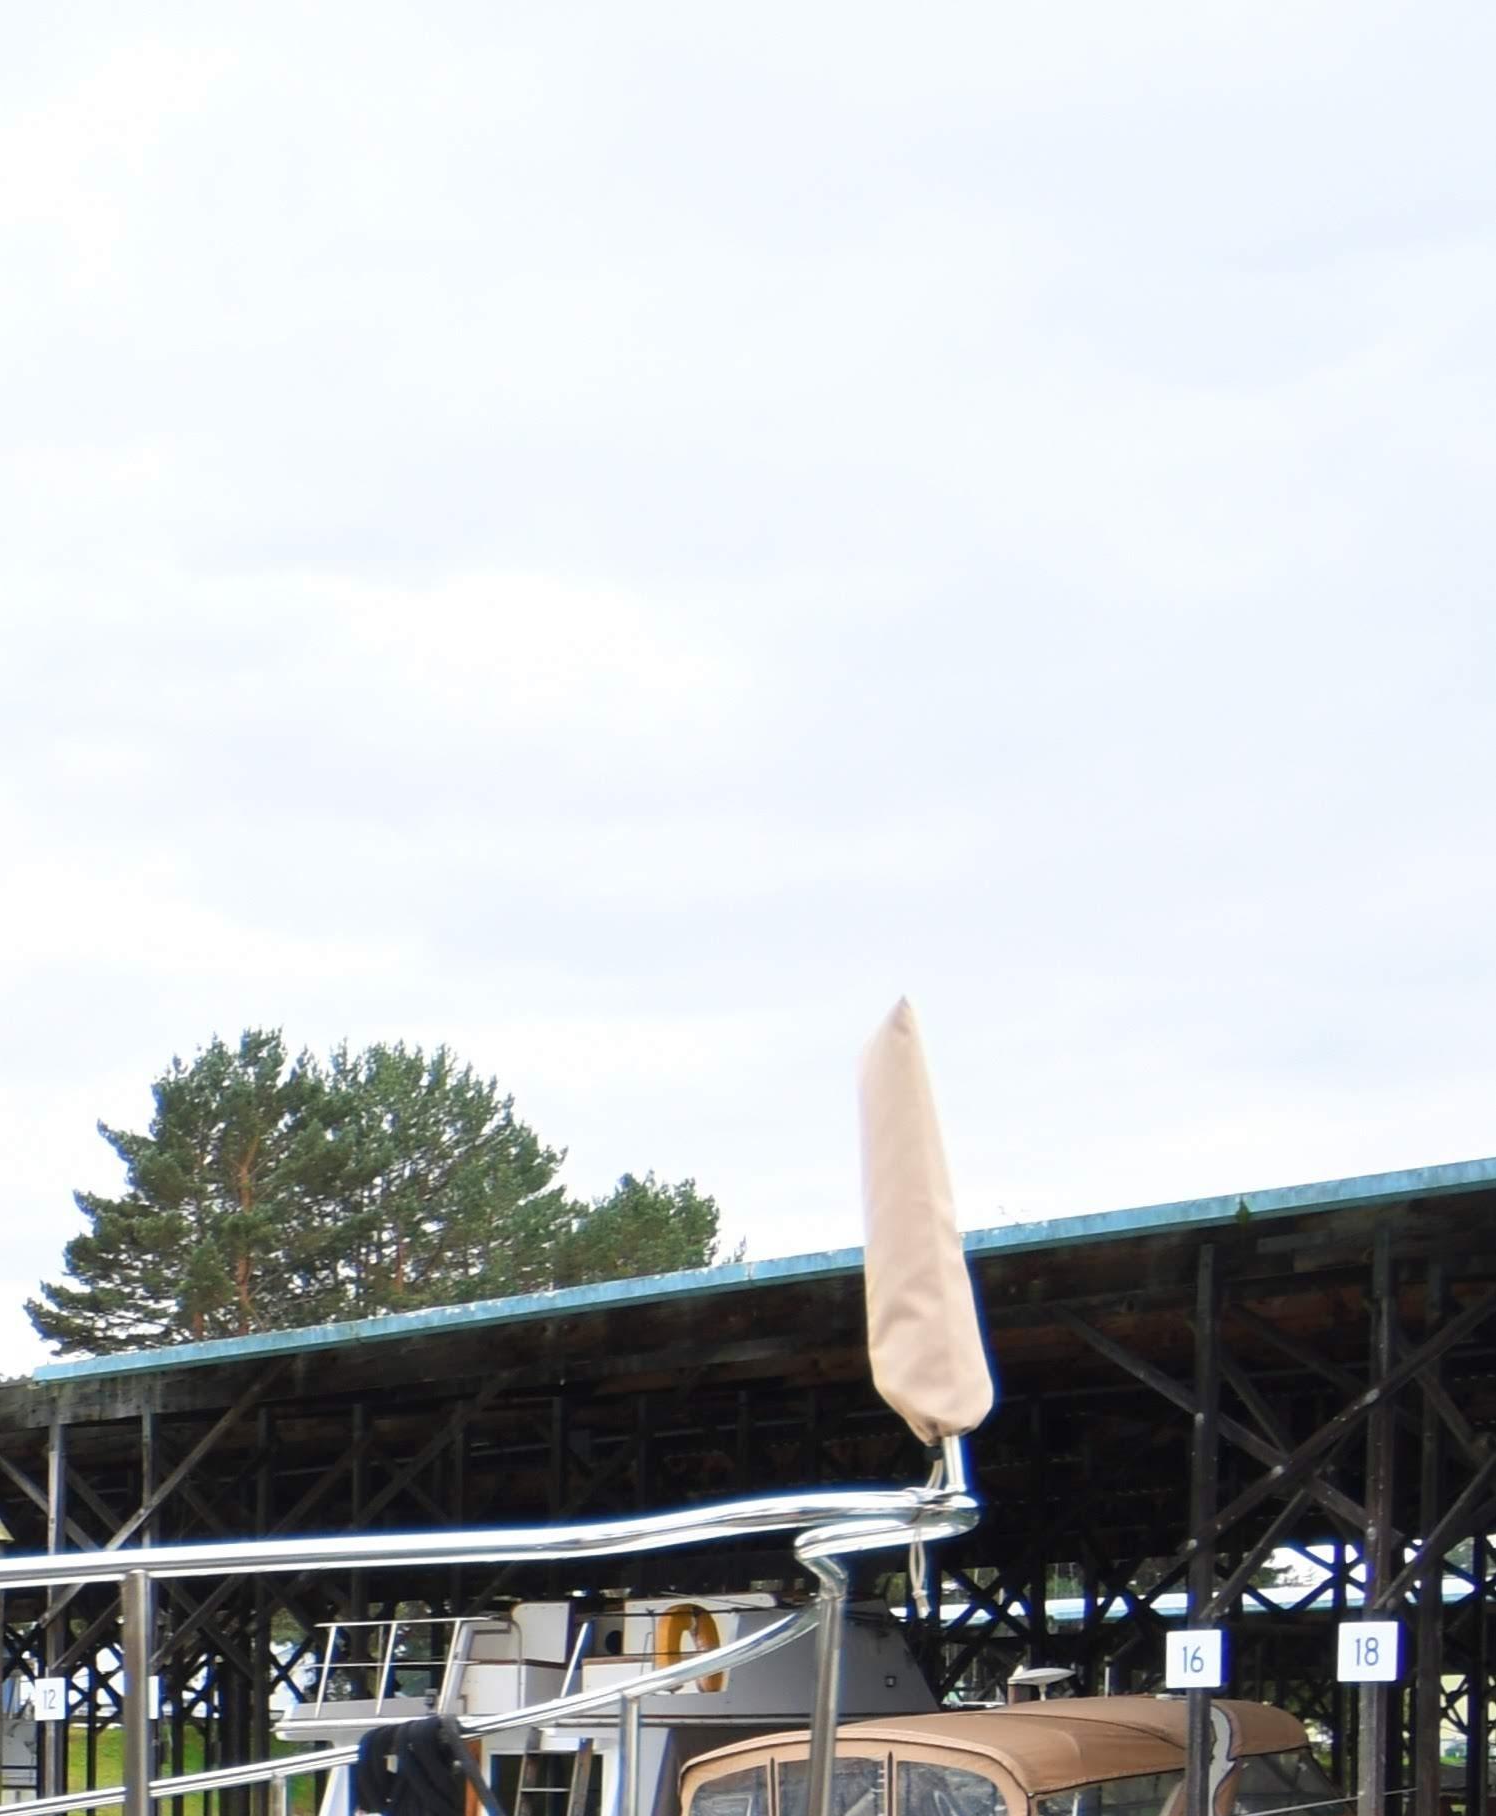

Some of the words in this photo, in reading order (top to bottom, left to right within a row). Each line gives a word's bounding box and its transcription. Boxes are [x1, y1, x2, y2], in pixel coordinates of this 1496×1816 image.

[1182, 1645, 1205, 1674] 16
[1355, 1637, 1379, 1666] 18
[43, 1689, 56, 1710] 12
